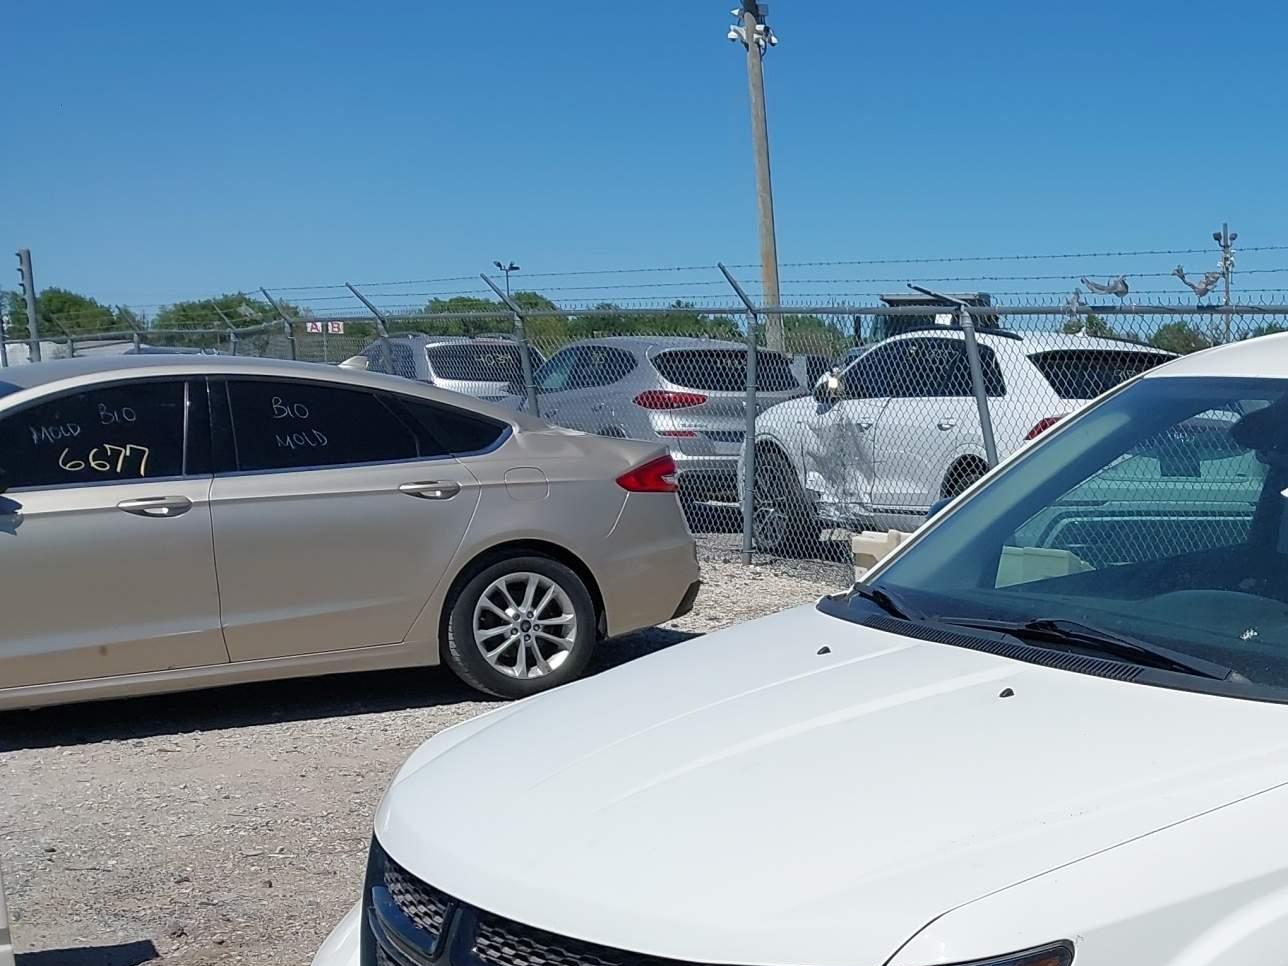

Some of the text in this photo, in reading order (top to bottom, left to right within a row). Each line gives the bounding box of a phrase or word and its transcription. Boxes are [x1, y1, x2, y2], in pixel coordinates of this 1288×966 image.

[29, 422, 81, 445] MOLD
[276, 428, 328, 449] MOLD
[58, 443, 149, 477] 6677
